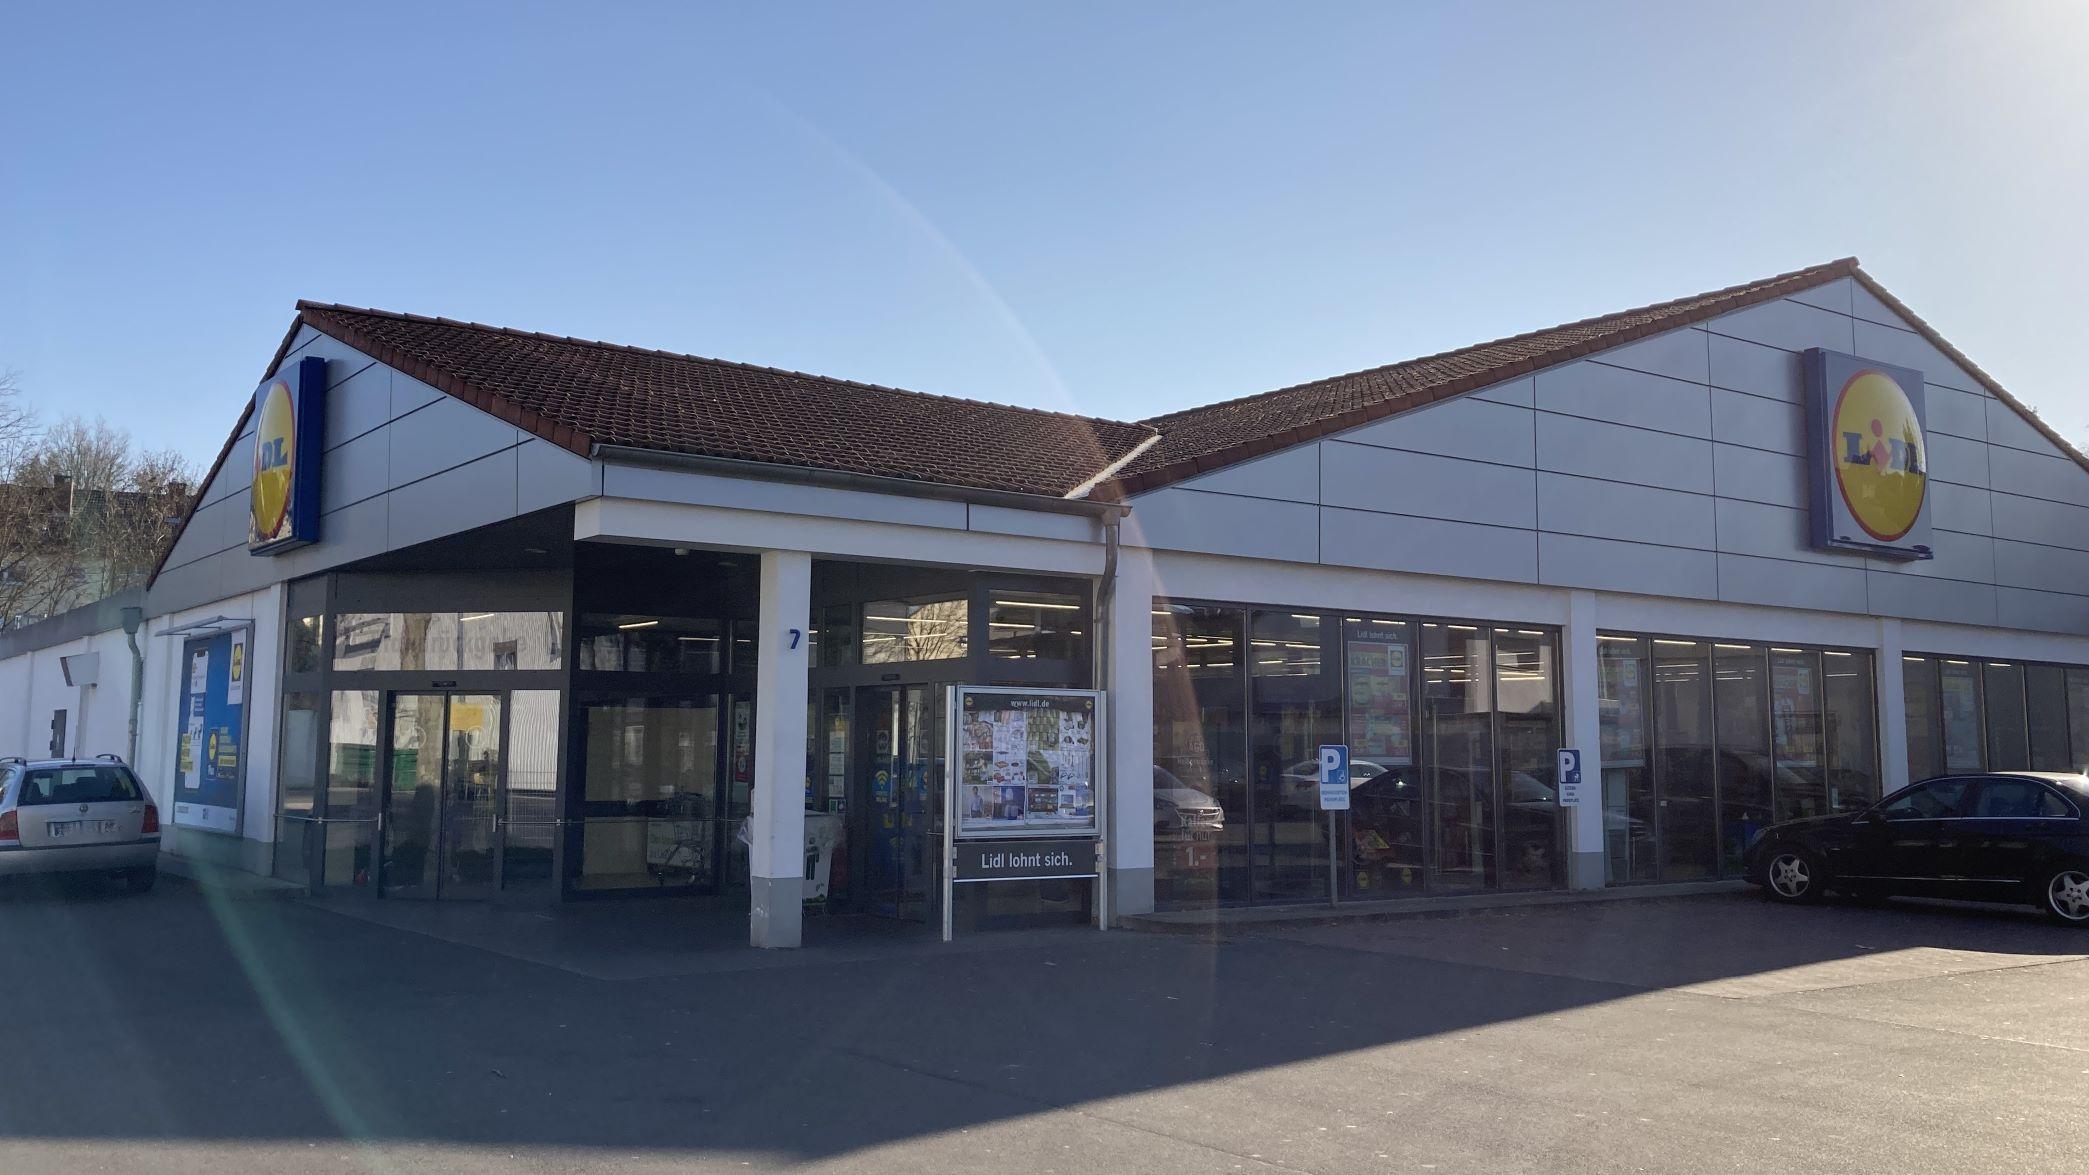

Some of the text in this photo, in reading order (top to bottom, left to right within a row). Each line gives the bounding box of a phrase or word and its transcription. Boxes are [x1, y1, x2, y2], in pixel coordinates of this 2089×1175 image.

[789, 629, 801, 650] 7
[1010, 699, 1050, 709] www.lidl.de
[1321, 748, 1341, 783] P
[1560, 751, 1576, 783] P
[981, 852, 1073, 869] Lidl lohnt sich.
